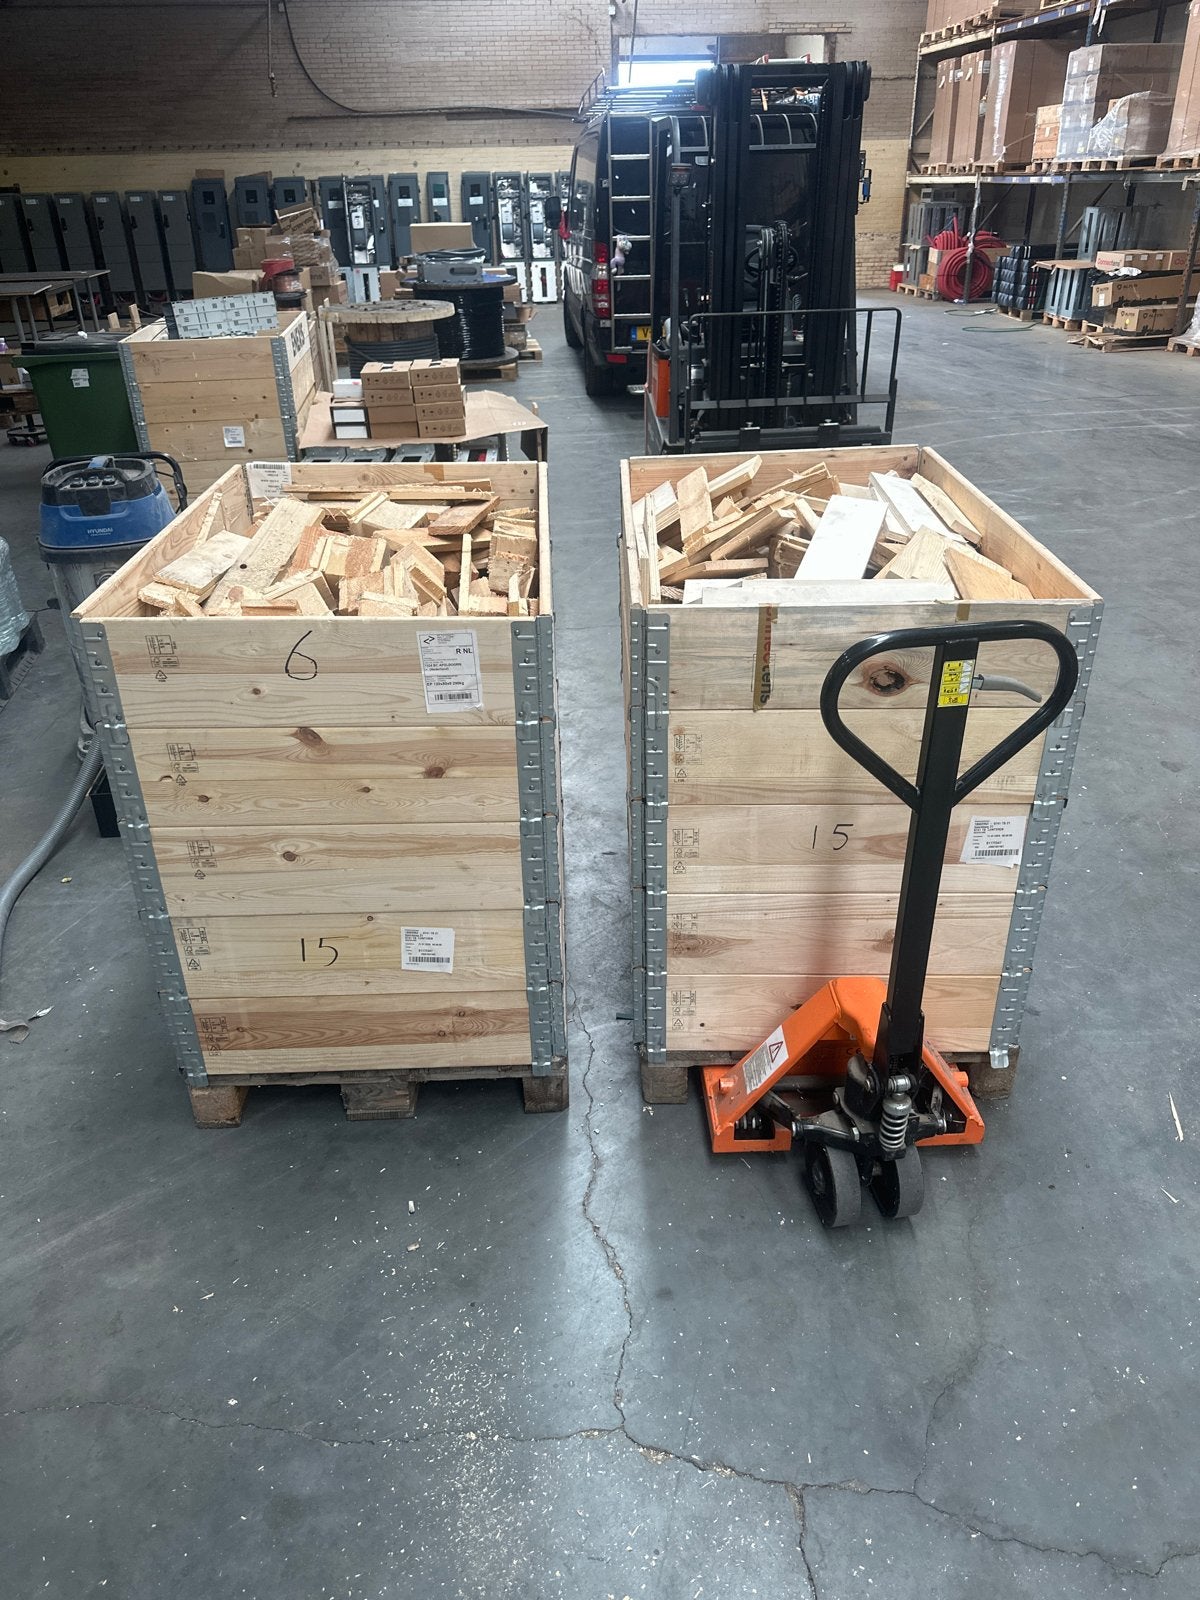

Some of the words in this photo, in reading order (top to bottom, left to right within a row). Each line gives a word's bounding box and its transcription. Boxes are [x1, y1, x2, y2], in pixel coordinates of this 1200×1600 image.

[285, 630, 318, 681] 6
[812, 823, 854, 851] 15
[301, 936, 350, 967] 15
